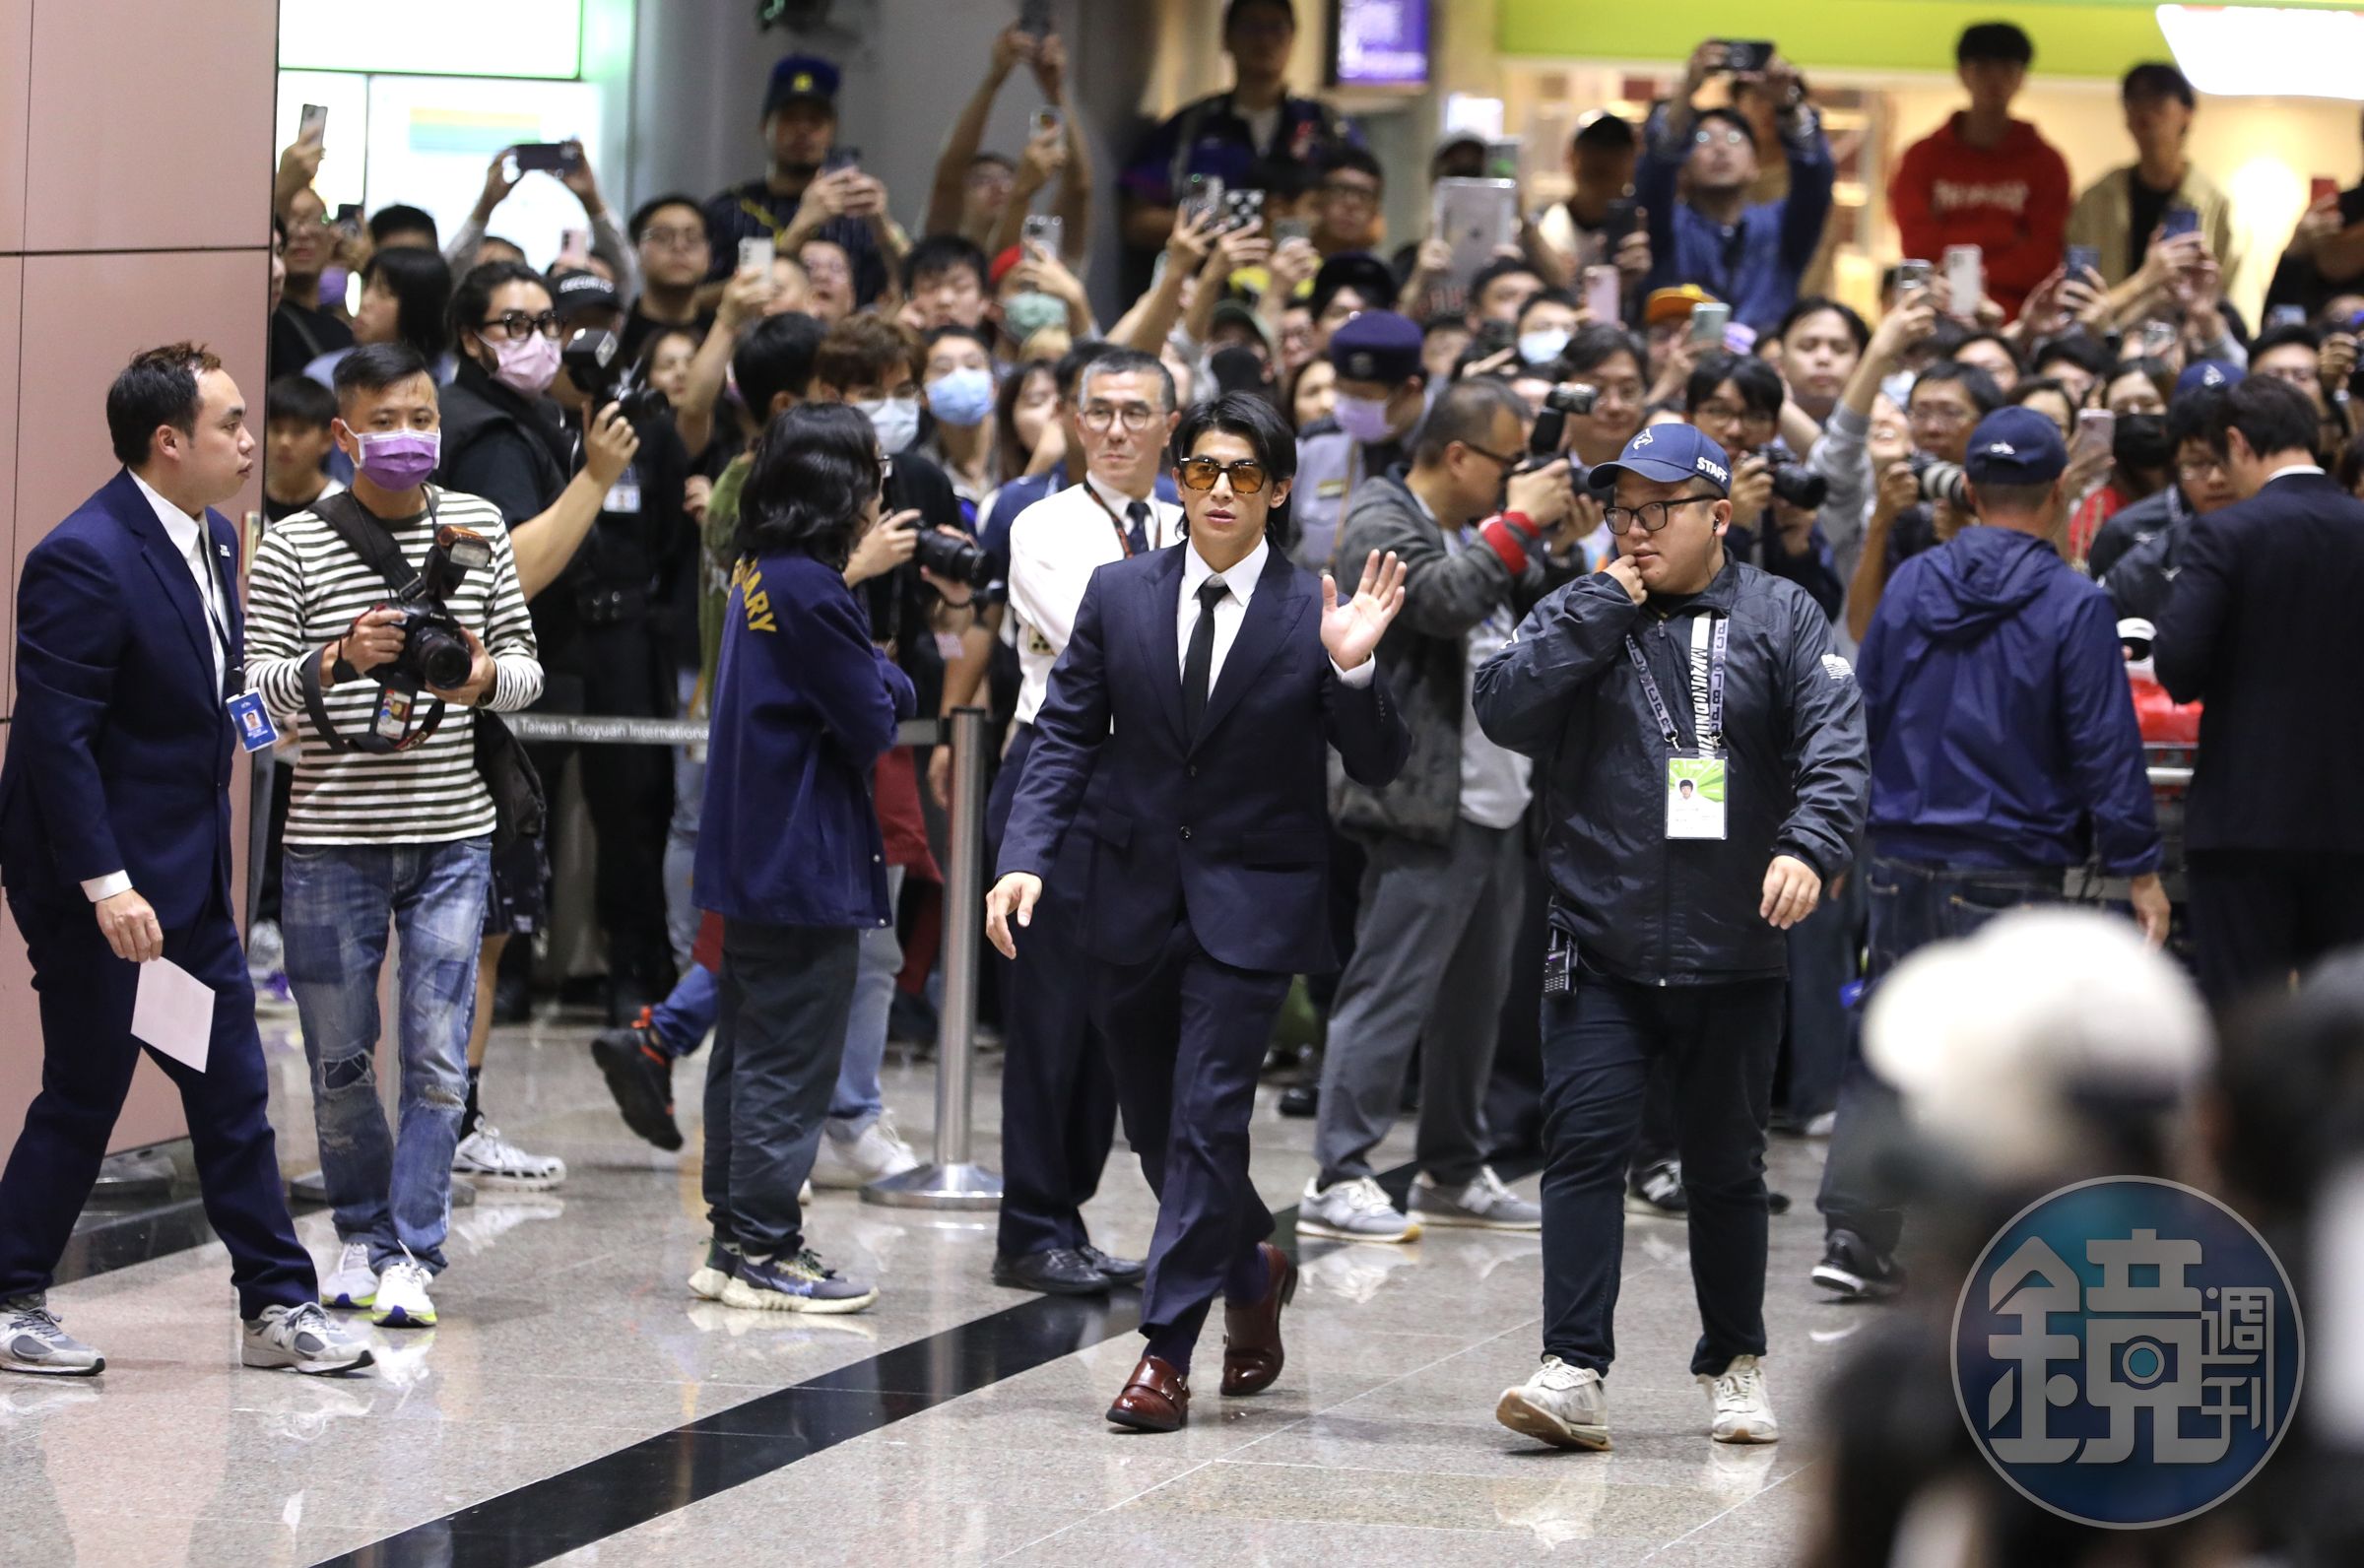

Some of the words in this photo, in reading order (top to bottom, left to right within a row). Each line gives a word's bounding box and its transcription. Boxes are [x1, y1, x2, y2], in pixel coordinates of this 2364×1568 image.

[1696, 456, 1728, 483] STAFF
[519, 717, 567, 735] Taiwan
[569, 718, 625, 741] Taoyuan
[628, 721, 709, 741] Internationa
